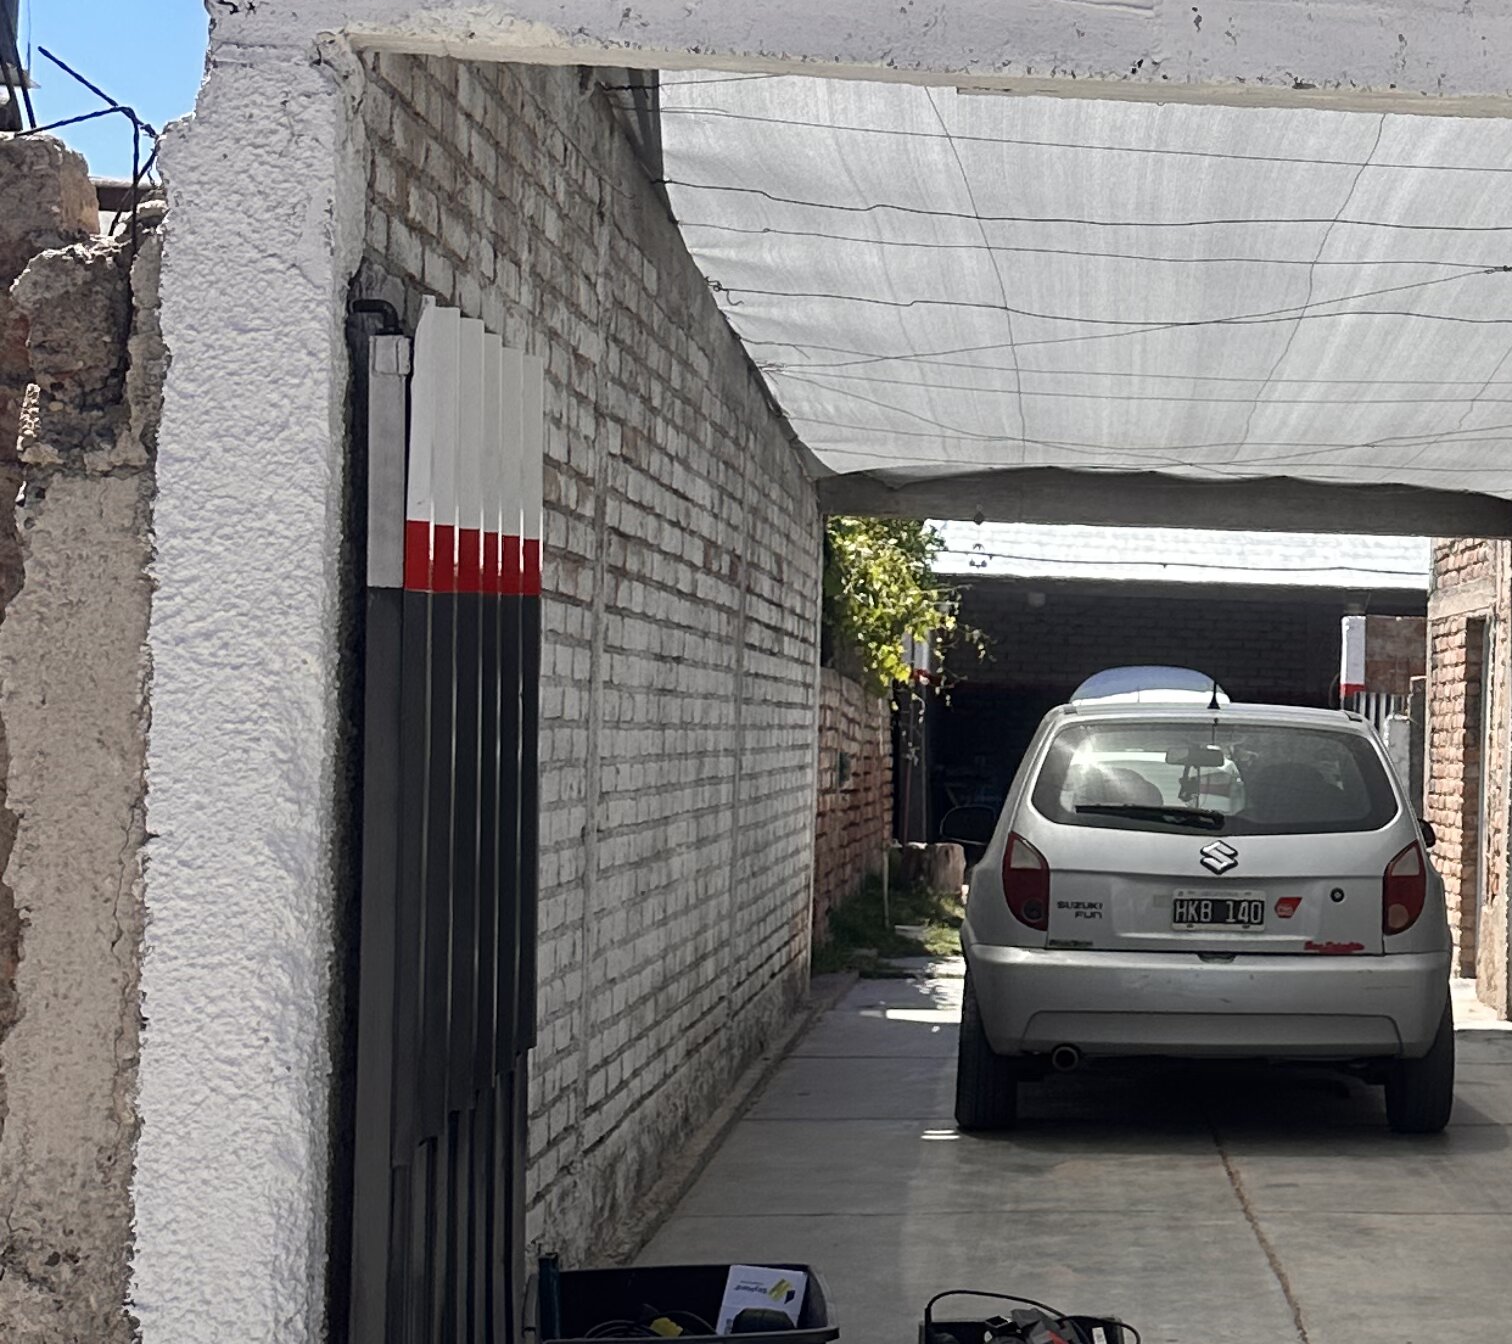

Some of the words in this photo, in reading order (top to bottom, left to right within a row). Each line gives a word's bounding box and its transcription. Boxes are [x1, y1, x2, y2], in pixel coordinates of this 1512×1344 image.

[1057, 901, 1103, 909] SUZUKI
[1175, 900, 1213, 923] HKB
[1226, 900, 1262, 924] 140
